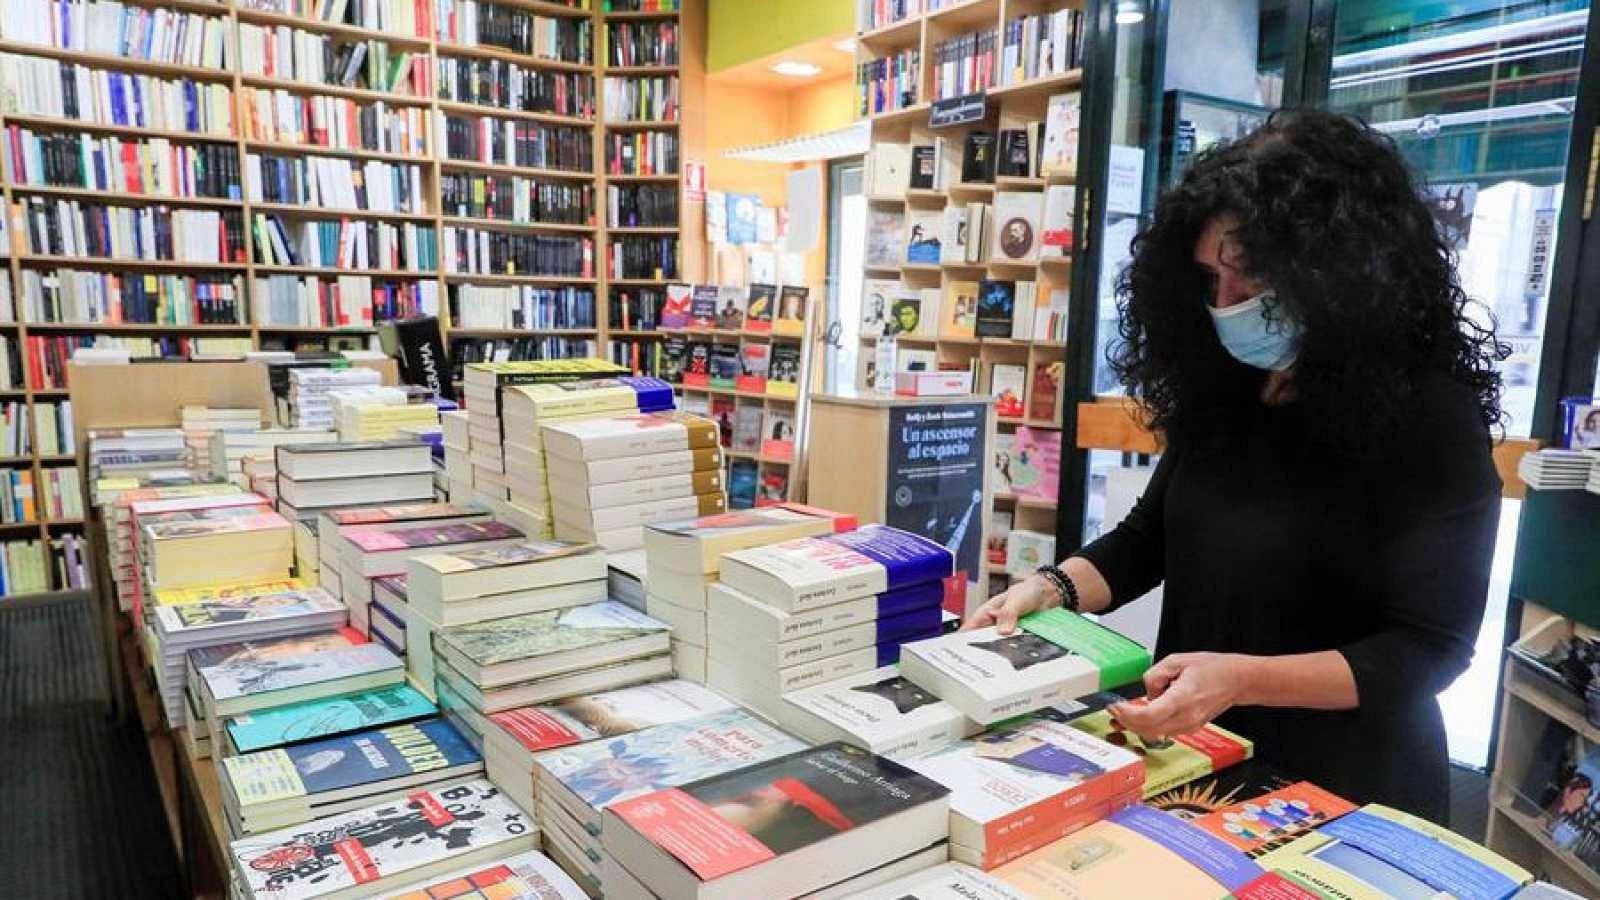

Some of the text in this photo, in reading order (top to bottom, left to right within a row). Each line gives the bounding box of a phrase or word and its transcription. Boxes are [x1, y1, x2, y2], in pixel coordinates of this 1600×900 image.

[903, 427, 977, 443] Un ascensor
[908, 440, 970, 460] al espacio
